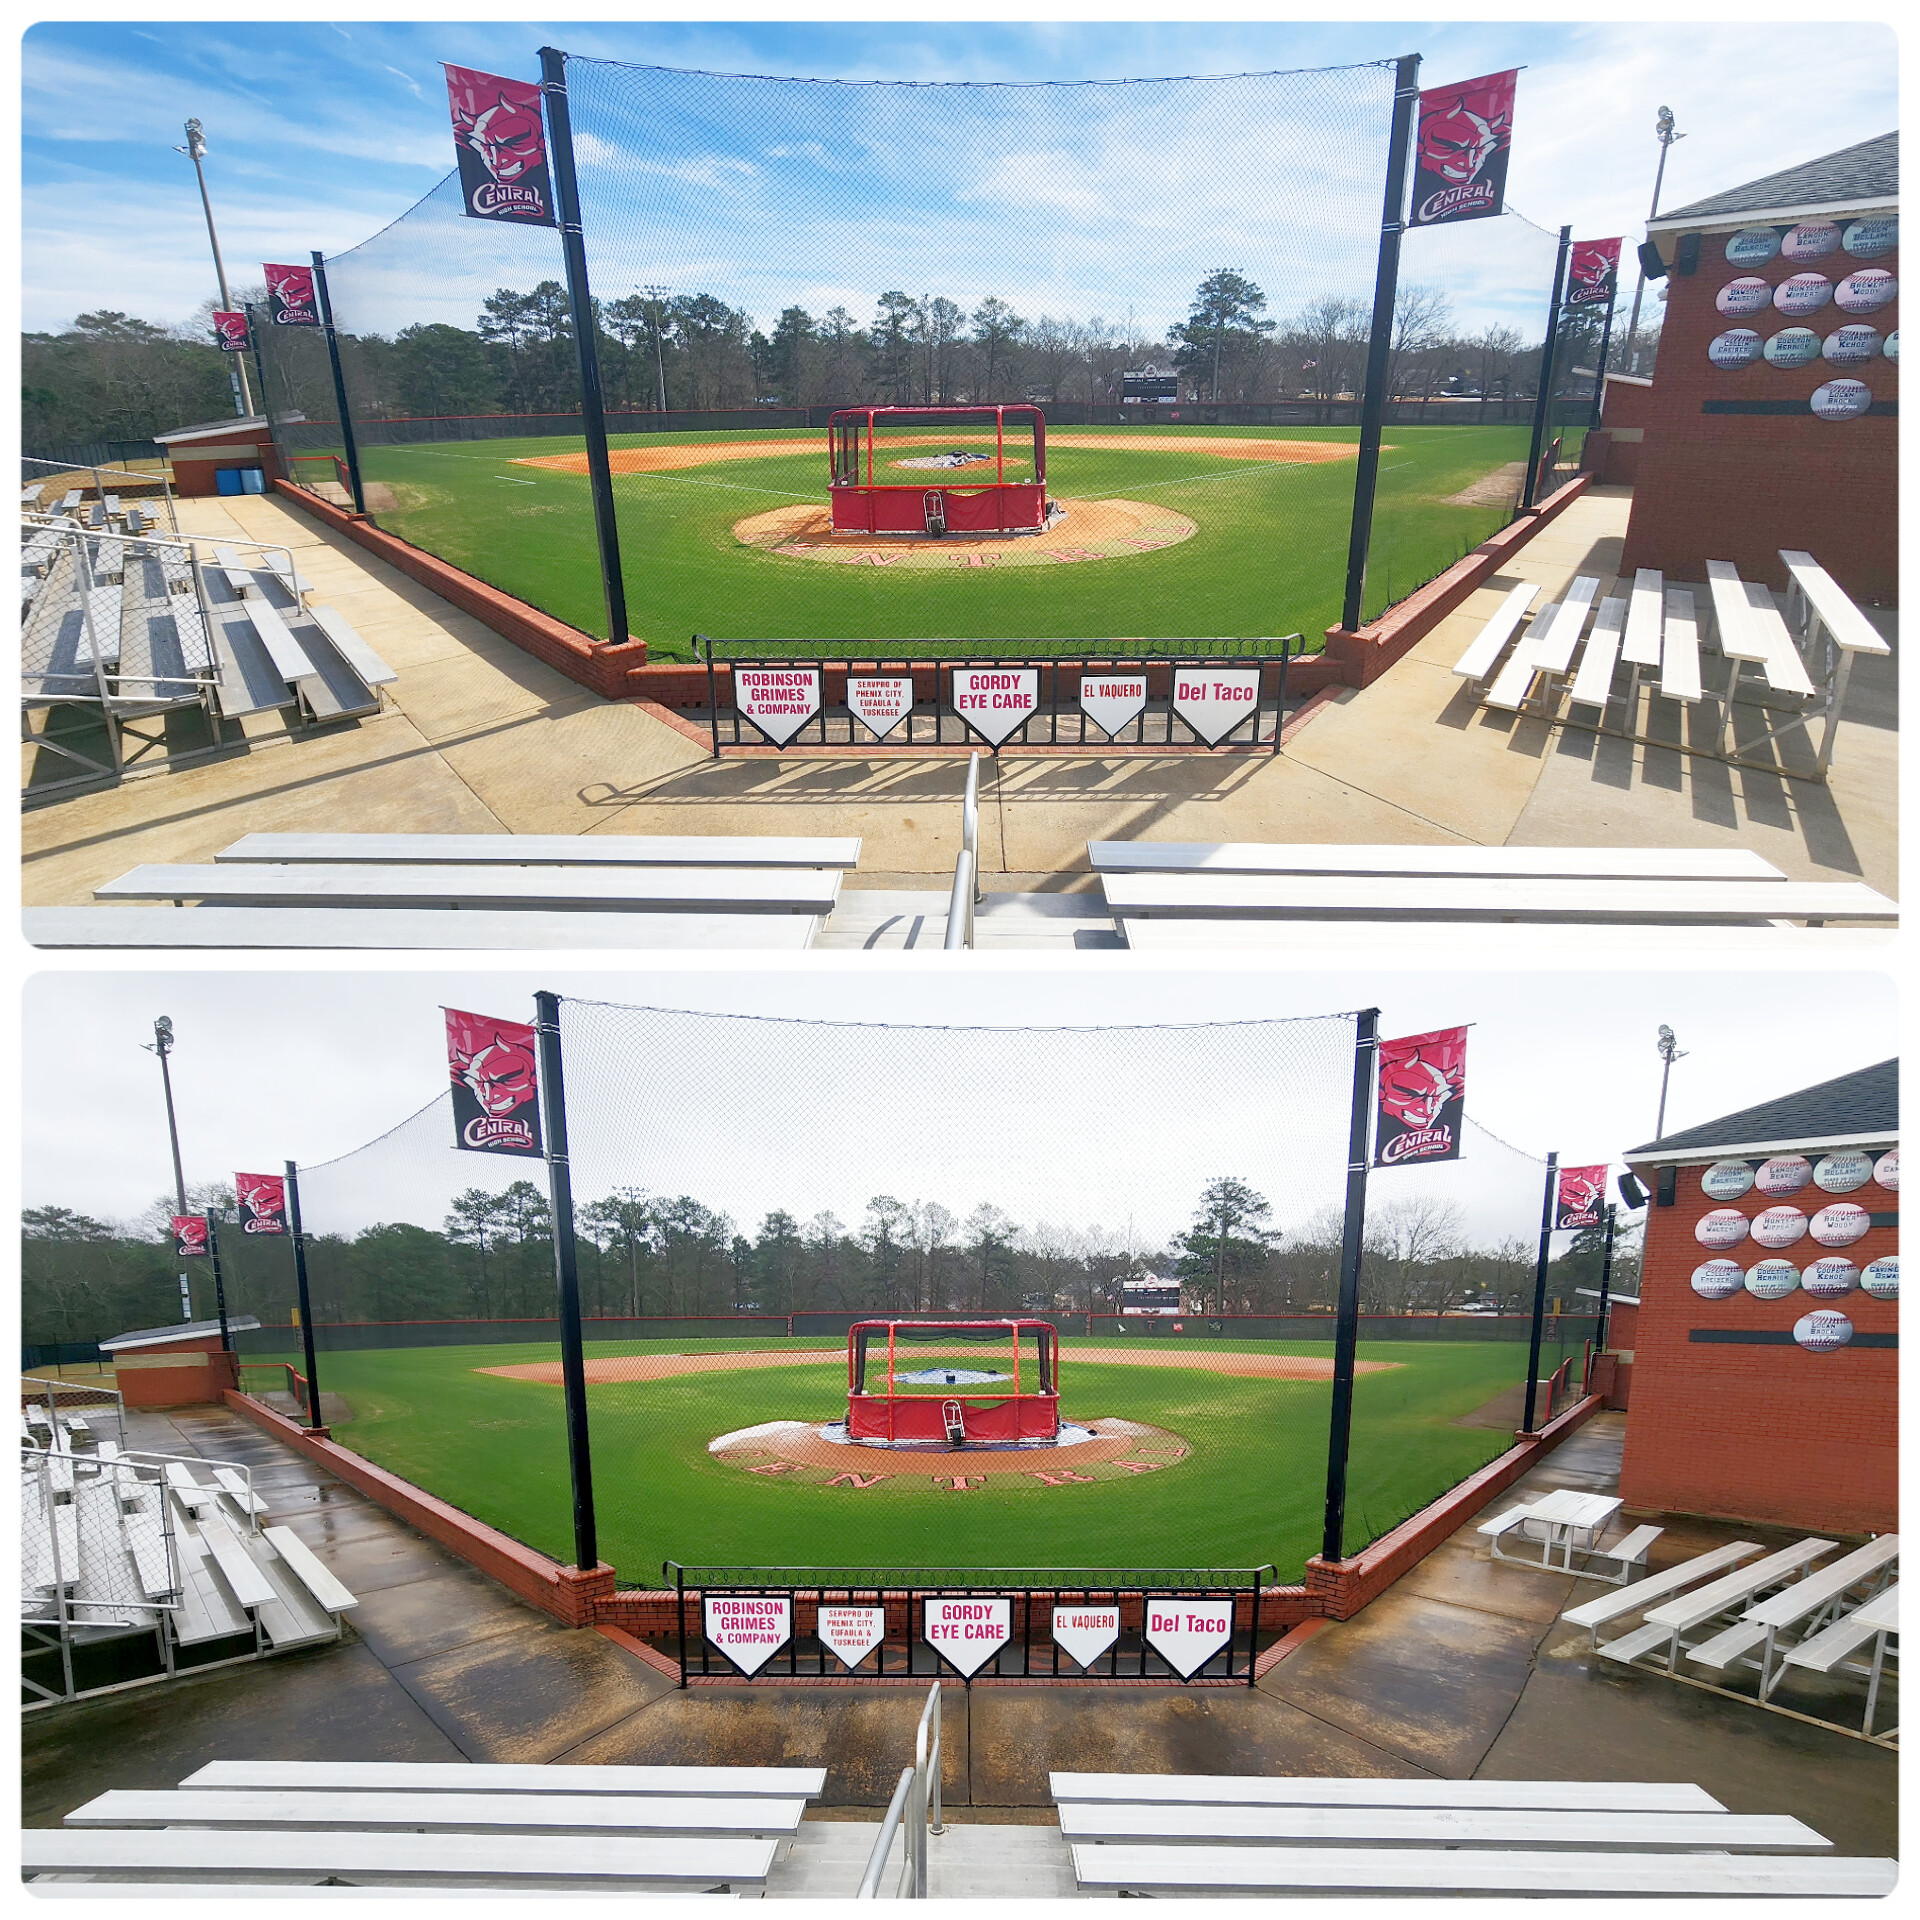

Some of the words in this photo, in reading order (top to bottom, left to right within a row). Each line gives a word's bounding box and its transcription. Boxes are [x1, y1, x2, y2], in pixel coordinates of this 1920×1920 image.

[472, 183, 544, 215] CENTRAL
[1418, 178, 1495, 222] CENTRAL
[498, 205, 513, 216] HIGH
[513, 204, 538, 212] SCHOOL
[1440, 206, 1458, 219] HIGH
[1458, 200, 1486, 210] SCHOOL
[1569, 284, 1610, 304] CENTRAL
[276, 309, 314, 324] CENTRAL
[742, 673, 812, 686] ROBINSON
[857, 680, 891, 689] SERVPRO
[893, 680, 902, 688] OF
[969, 674, 1021, 691] GORDY
[751, 688, 805, 701] GRIMES
[856, 689, 882, 698] PHENIX
[1084, 684, 1095, 698] EL
[1099, 684, 1142, 700] VAQUERO
[1178, 682, 1207, 701] Del
[1213, 682, 1254, 701] Taco
[860, 699, 892, 707] EUFAULA
[895, 699, 901, 707] &
[959, 694, 987, 709] EYE
[992, 693, 1032, 709] CARE
[746, 703, 755, 715] &
[758, 703, 811, 715] COMPANY
[862, 708, 899, 717] TUSKEGEE
[463, 1116, 533, 1147] CENTRAL
[1381, 1123, 1453, 1164] CENTRAL
[1824, 1168, 1862, 1176] BELLAMY
[244, 1218, 283, 1233] CENTRAL
[1559, 1210, 1599, 1229] CENTRAL
[712, 1601, 784, 1615] ROBINSON
[828, 1610, 862, 1618] SERVPRO
[865, 1610, 874, 1618] OF
[941, 1604, 993, 1621] GORDY
[720, 1616, 776, 1630] GRIMES
[827, 1619, 854, 1628] PHENIX
[857, 1619, 876, 1629] CITY,
[1056, 1615, 1067, 1629] EL
[1071, 1614, 1115, 1631] VAQUERO
[1151, 1614, 1180, 1633] Del
[1185, 1614, 1226, 1633] Taco
[715, 1633, 724, 1644] &
[727, 1633, 781, 1644] COMPANY
[830, 1629, 863, 1637] EUFAULA
[866, 1629, 872, 1637] &
[931, 1624, 959, 1640] EYE
[964, 1624, 1005, 1640] CARE
[833, 1638, 870, 1647] TUSKEGEE
